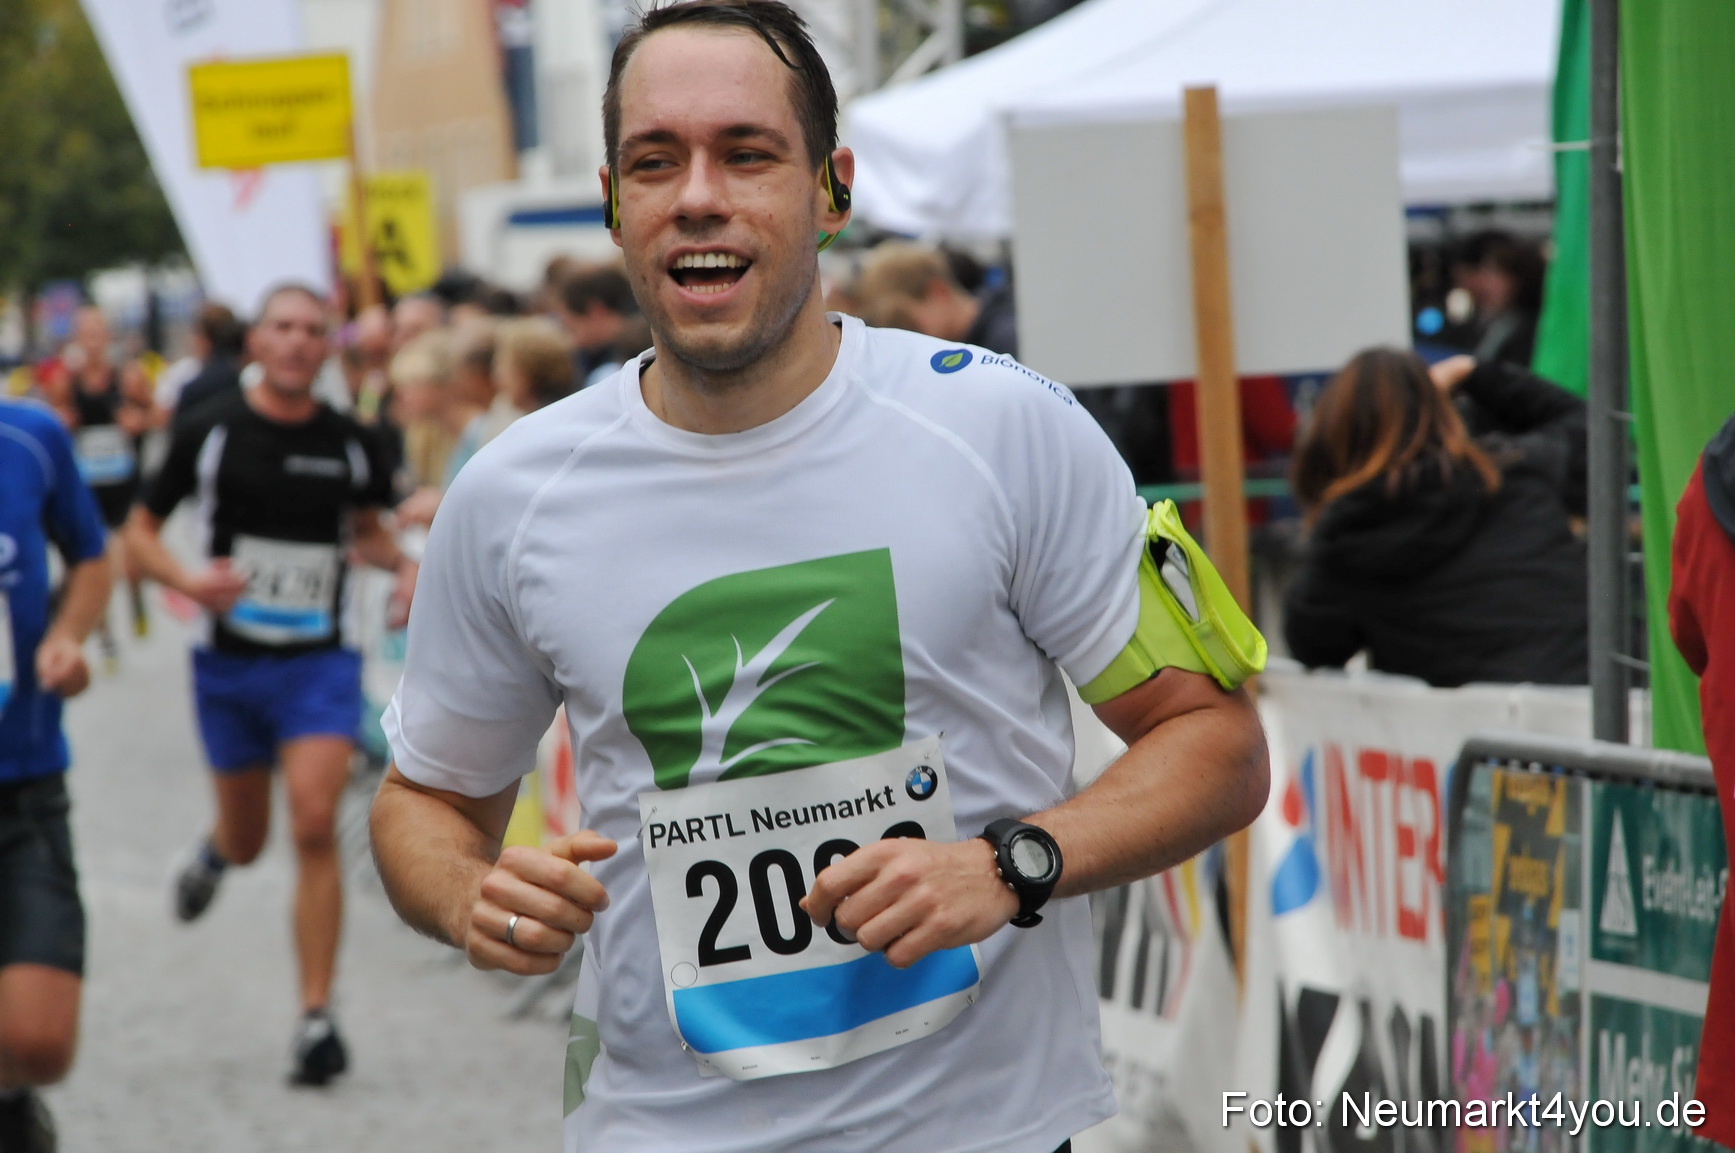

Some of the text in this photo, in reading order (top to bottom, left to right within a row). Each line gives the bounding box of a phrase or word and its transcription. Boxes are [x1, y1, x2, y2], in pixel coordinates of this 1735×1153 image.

[980, 354, 1074, 406] Bionorica
[649, 785, 896, 849] PARTL Neumarkt
